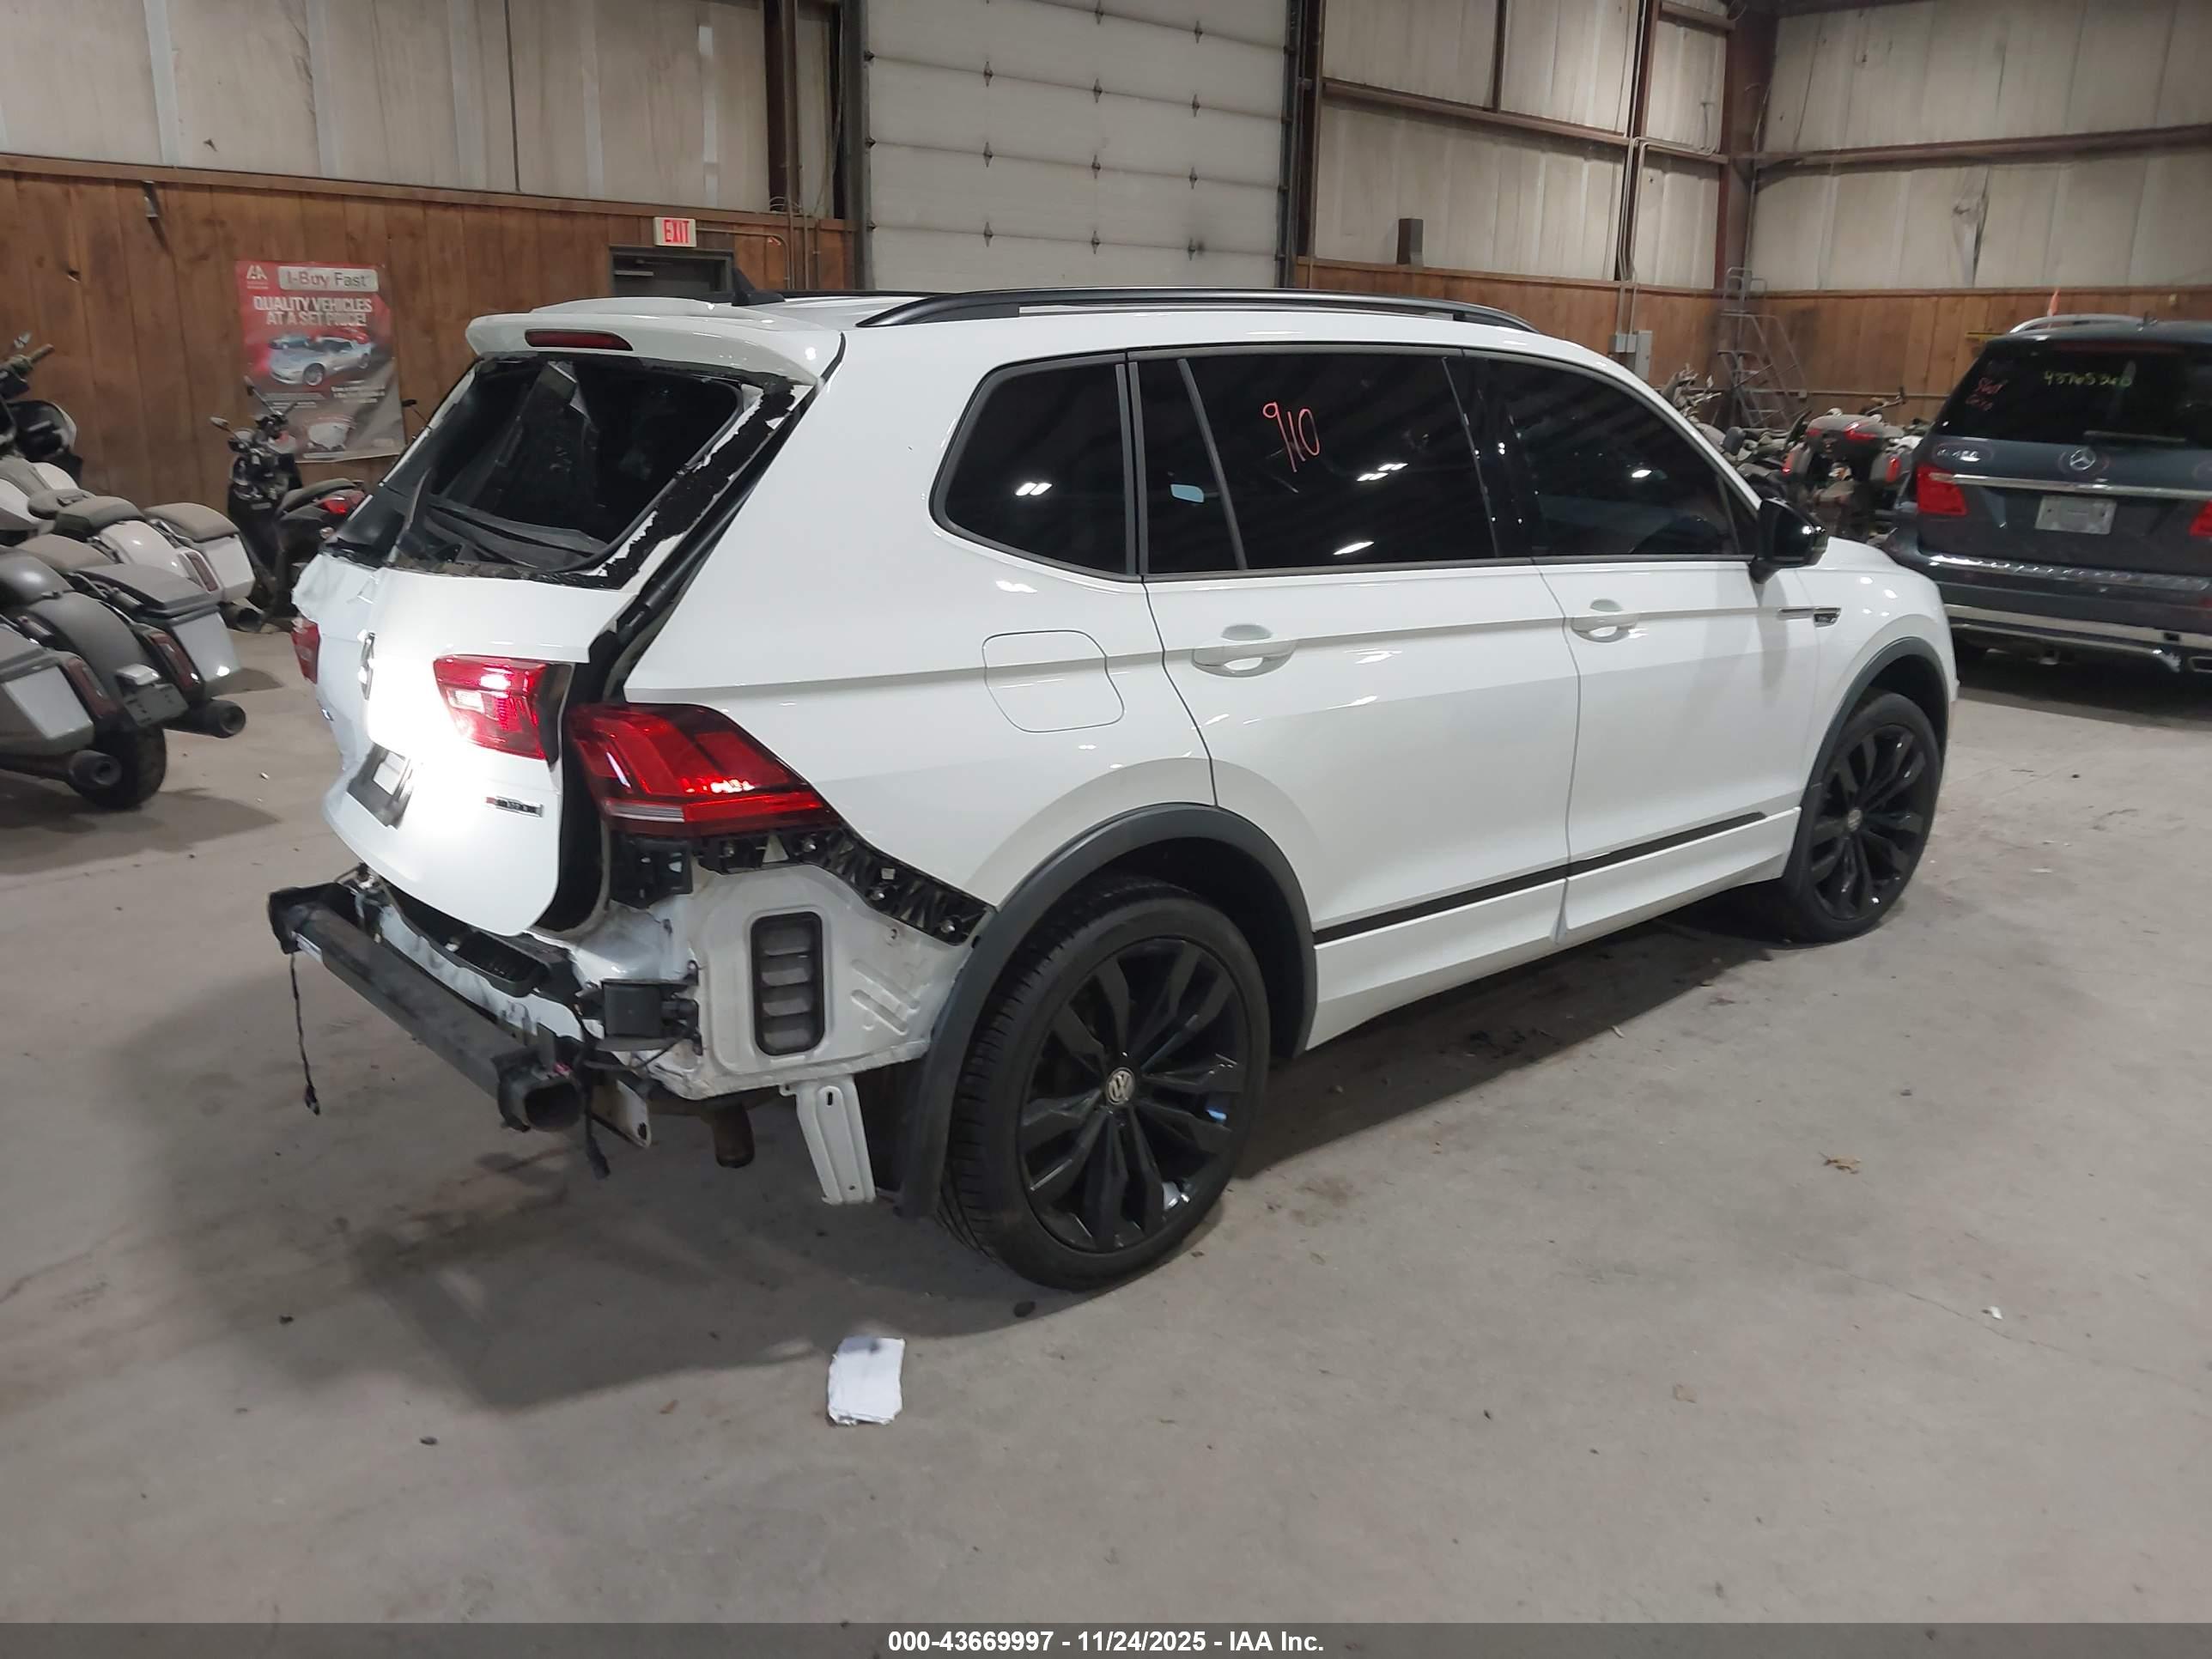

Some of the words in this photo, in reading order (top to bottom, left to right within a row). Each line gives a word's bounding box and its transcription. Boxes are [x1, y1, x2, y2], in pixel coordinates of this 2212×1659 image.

[663, 219, 690, 243] EXIT
[287, 270, 330, 289] I-Buy
[334, 271, 367, 288] Fast
[253, 295, 309, 312] QUALITY
[311, 297, 373, 313] VEHICLES
[266, 311, 284, 325] AT
[286, 312, 297, 325] A
[298, 312, 325, 326] SET
[1262, 401, 1320, 472] 910
